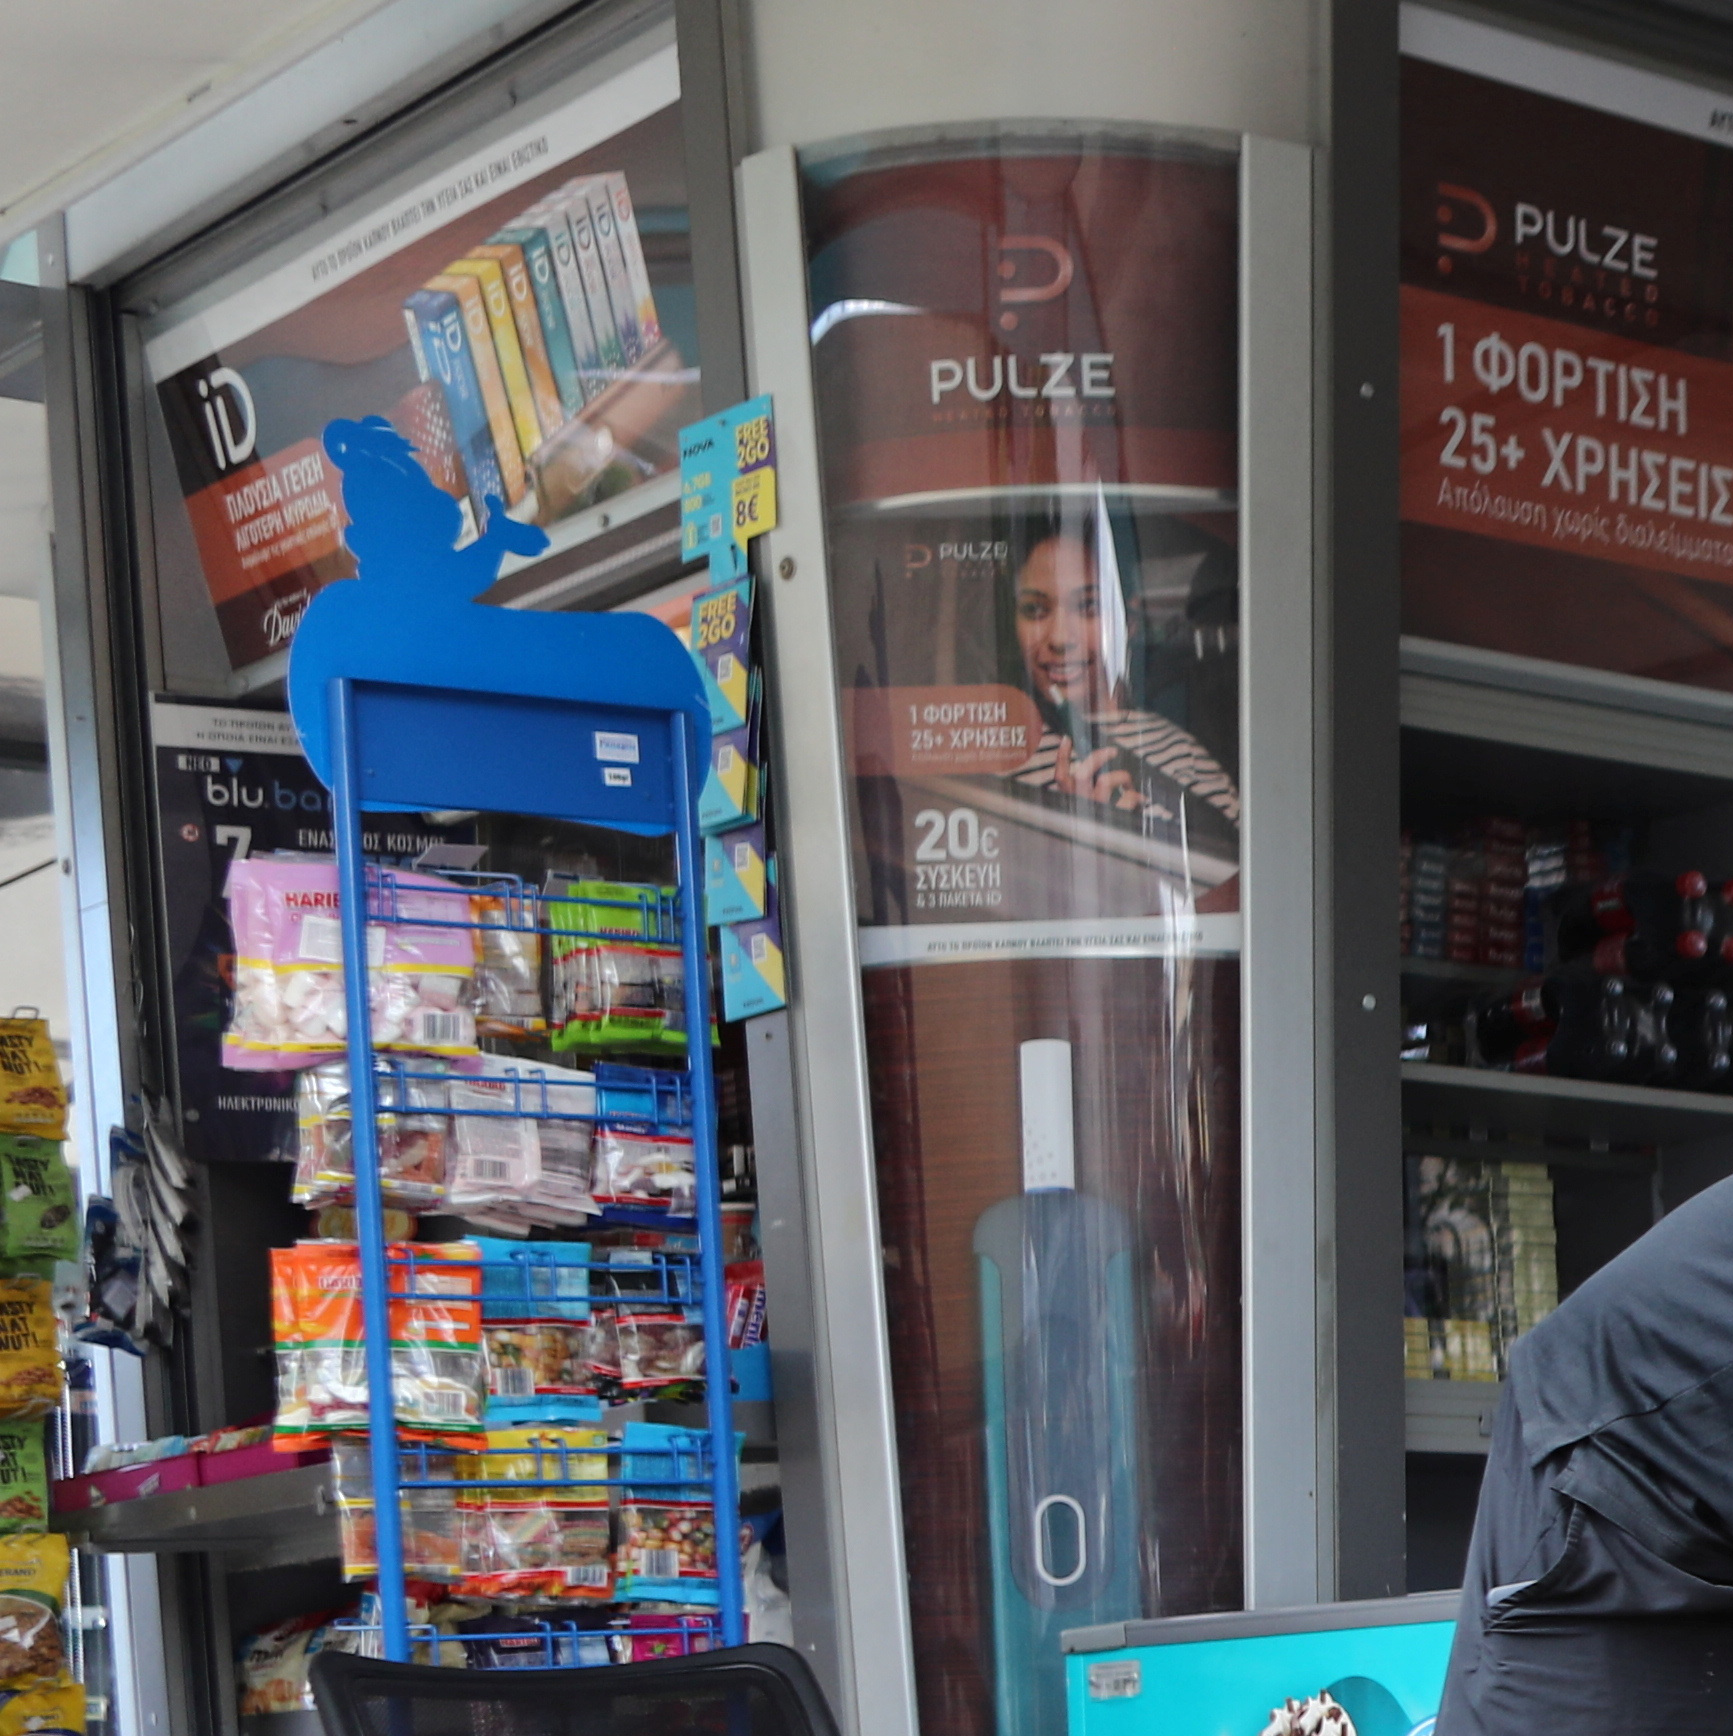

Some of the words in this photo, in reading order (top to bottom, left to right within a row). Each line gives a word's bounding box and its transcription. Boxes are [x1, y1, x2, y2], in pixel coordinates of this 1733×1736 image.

[1514, 202, 1658, 279] PULZE
[931, 353, 1115, 404] PULZE
[1437, 321, 1456, 384] 1
[1472, 330, 1688, 437] ΦΟΡΤΙΣΗ
[736, 415, 769, 441] FREE
[1438, 405, 1525, 475] 25+
[737, 438, 769, 469] 2GO
[224, 472, 282, 523] ΠΛΟΥΣΙΑ
[282, 454, 324, 497] ΓΕΥΣΗ
[736, 494, 759, 526] 8€
[940, 540, 1008, 561] PULZE
[699, 590, 737, 622] FREE
[698, 616, 736, 650] 2GO
[923, 702, 1006, 724] ΦΟΡΤΙΣΗ
[911, 730, 944, 750] 25+
[950, 725, 1027, 748] ΧΡΗΣΕΙΣ
[207, 775, 264, 809] blu
[915, 862, 1000, 890] ΣΥΣΚΕΥΗ
[285, 892, 341, 909] HARIB
